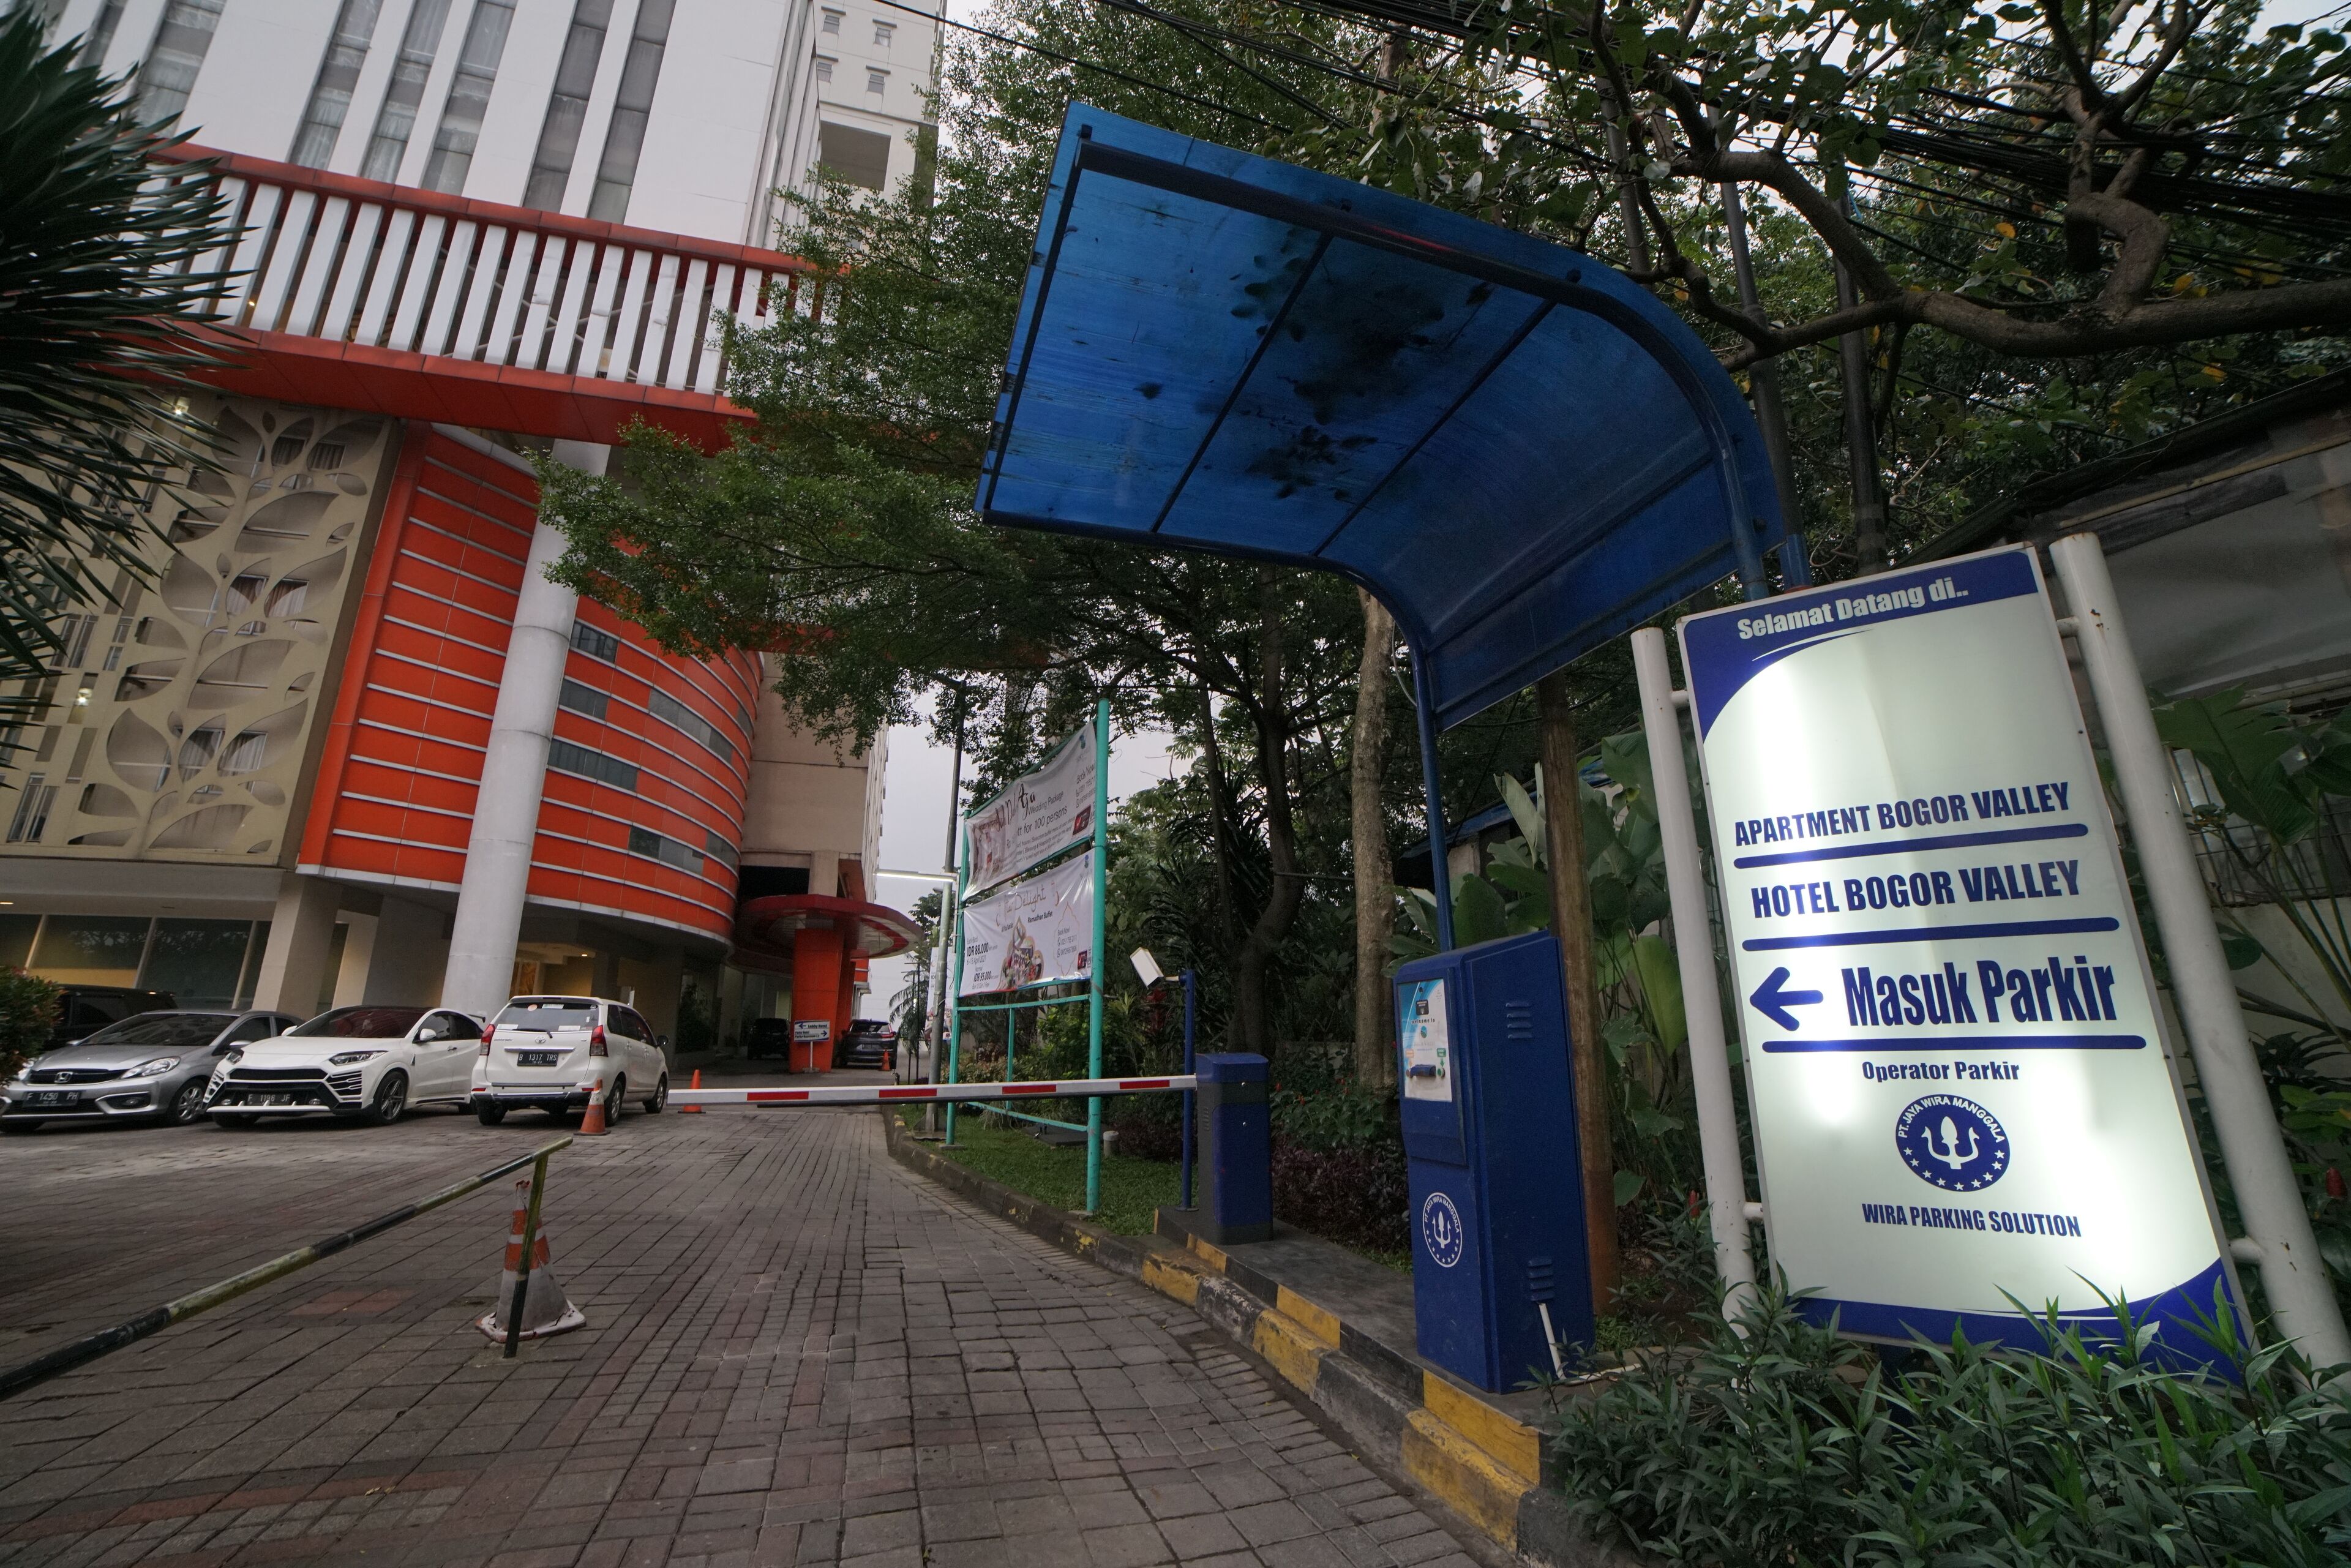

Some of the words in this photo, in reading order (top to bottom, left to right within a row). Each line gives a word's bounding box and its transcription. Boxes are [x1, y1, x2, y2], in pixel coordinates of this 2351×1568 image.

[1738, 602, 1834, 640] Selamat
[1837, 586, 1924, 621] Datang
[1024, 823, 1033, 833] for
[1035, 816, 1045, 830] 100
[1046, 805, 1068, 828] persons
[1734, 805, 1870, 847] APARTMENT
[1878, 790, 1970, 829] BOGOR
[1971, 781, 2069, 819] VALLEY
[1751, 881, 1840, 918] HOTEL
[1843, 871, 1955, 912] BOGOR
[1958, 859, 2079, 902] VALLEY
[975, 942, 989, 955] 88.000
[1840, 962, 1978, 1027] Masuk
[1977, 956, 2118, 1024] Parkir
[1862, 1061, 1949, 1082] Operator
[1955, 1060, 2020, 1081] Parkir
[1903, 1103, 1924, 1124] JAYA
[1920, 1096, 1951, 1108] WIRA
[1898, 1124, 1909, 1138] PT.
[1952, 1097, 2005, 1143] MANGGALA
[1443, 1198, 1460, 1233] MANGGALA
[1861, 1203, 1908, 1226] WIRA
[1911, 1207, 1985, 1231] PARKING
[1990, 1212, 2082, 1237] SOLUTION
